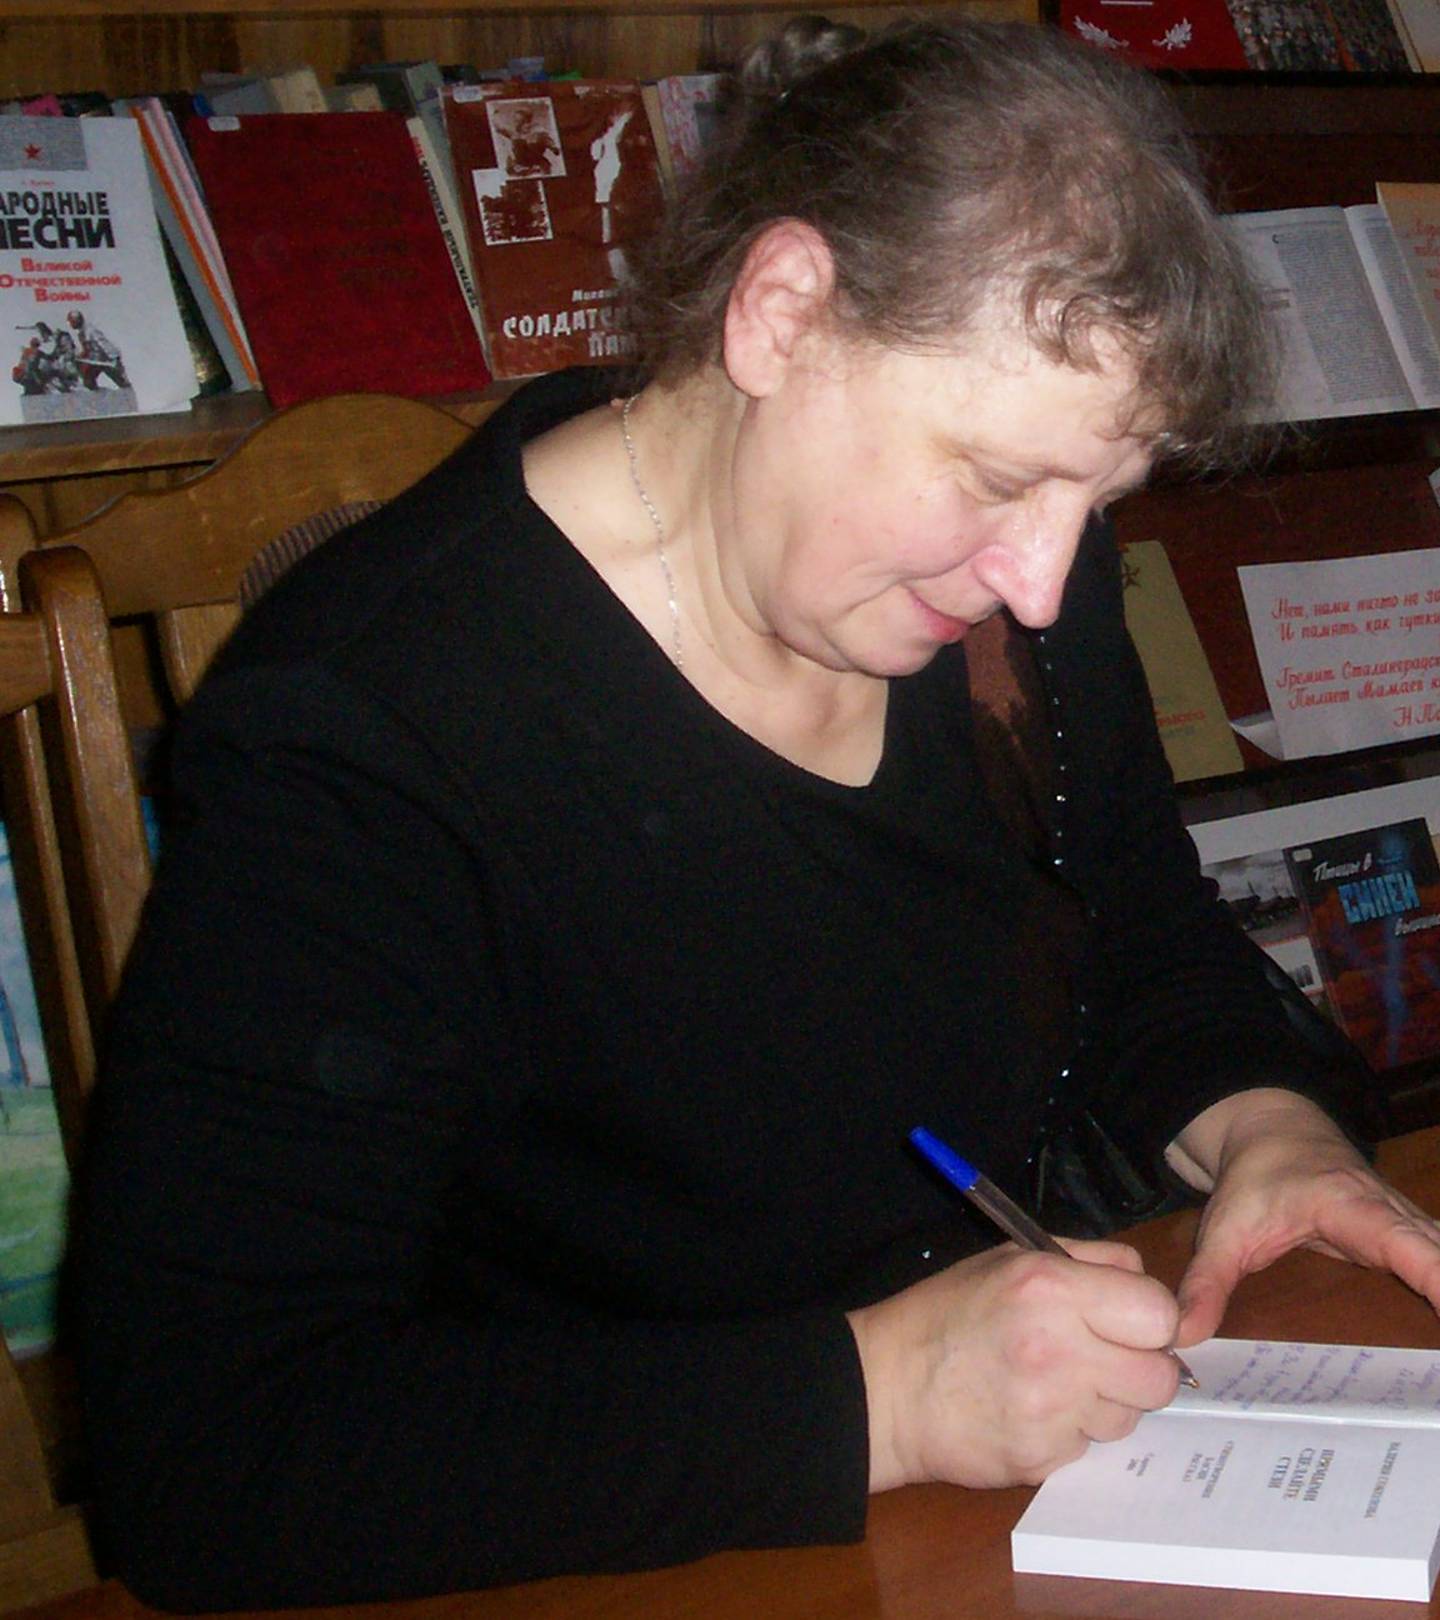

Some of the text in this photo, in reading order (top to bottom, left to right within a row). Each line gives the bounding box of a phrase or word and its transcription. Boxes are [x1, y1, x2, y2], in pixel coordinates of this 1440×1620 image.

[0, 191, 110, 219] АРОДНЫЕ
[1313, 600, 1350, 616] нами
[1403, 592, 1420, 608] не
[1280, 622, 1295, 642] И
[1365, 618, 1392, 637] как
[1275, 665, 1335, 692] Гремит
[1288, 686, 1350, 711] Пылает
[1356, 679, 1425, 700] Мамаев
